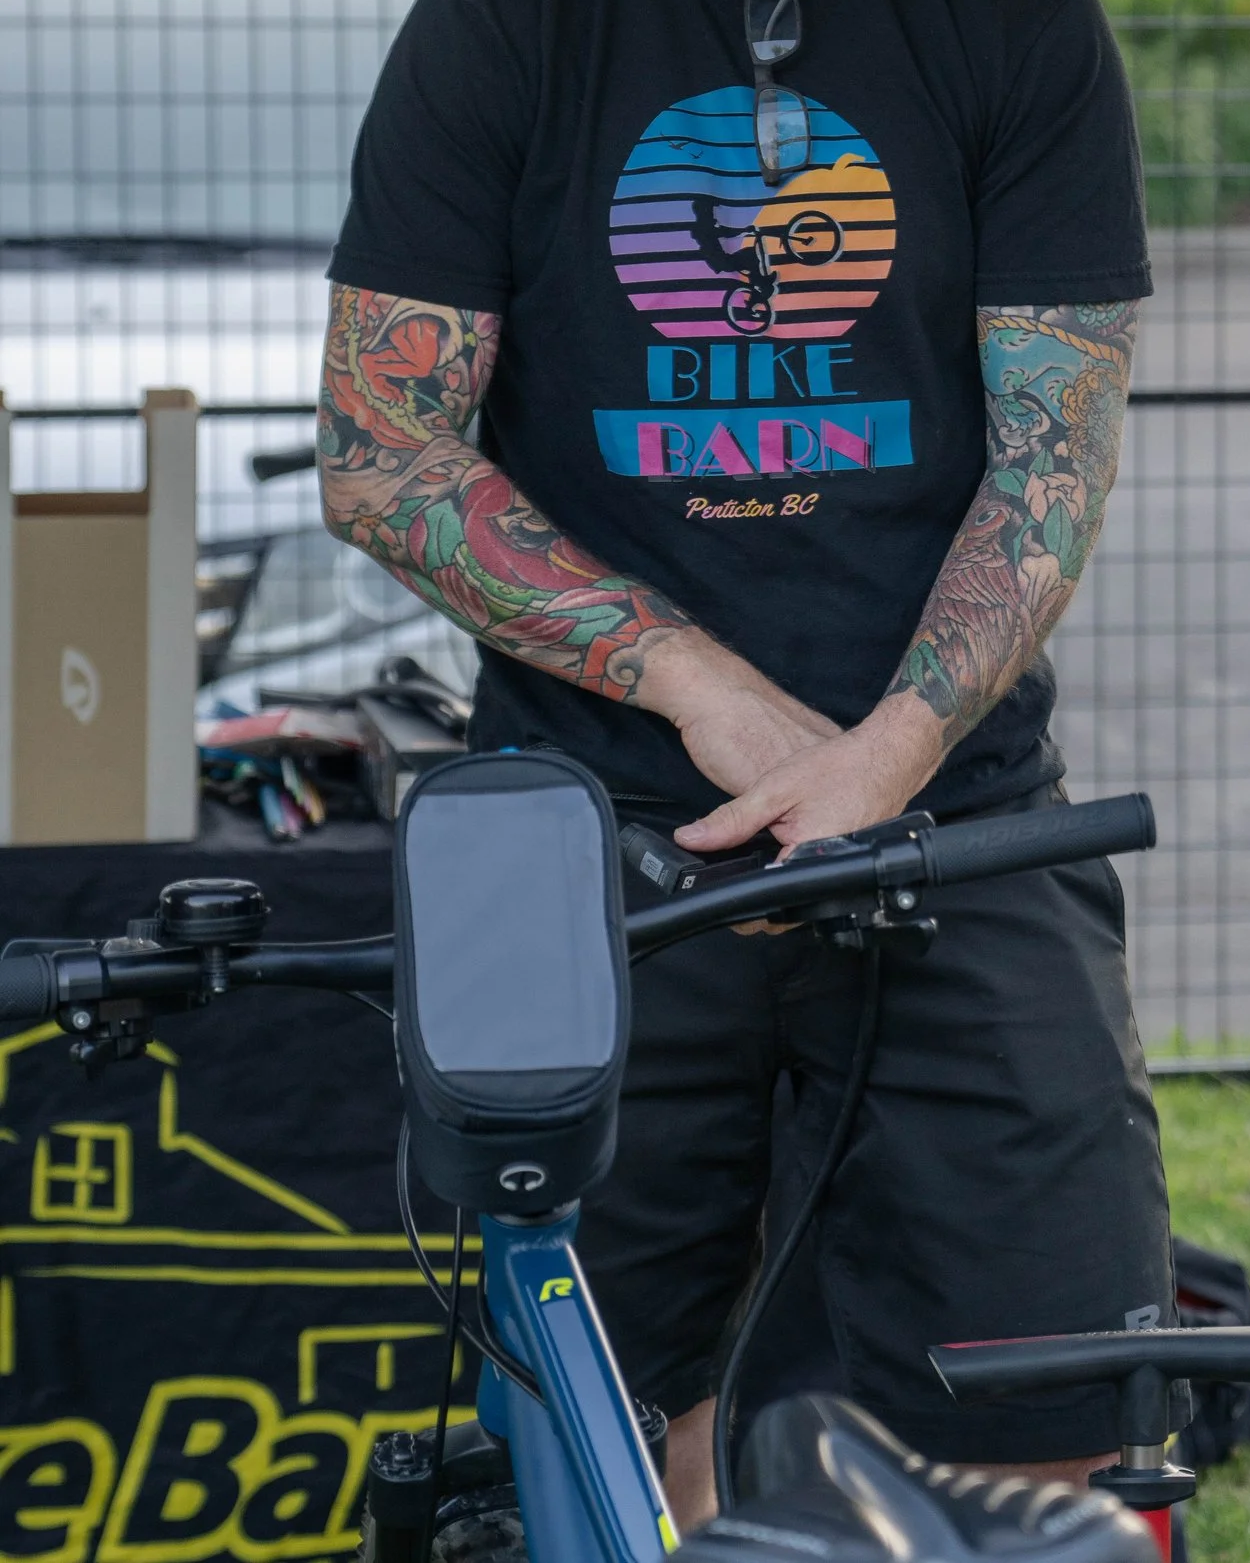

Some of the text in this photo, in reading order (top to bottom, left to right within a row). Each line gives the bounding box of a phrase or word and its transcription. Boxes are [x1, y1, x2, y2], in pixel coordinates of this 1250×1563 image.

[646, 343, 859, 402] BIKE
[637, 415, 876, 482] BARN
[685, 492, 821, 520] Penticton BC
